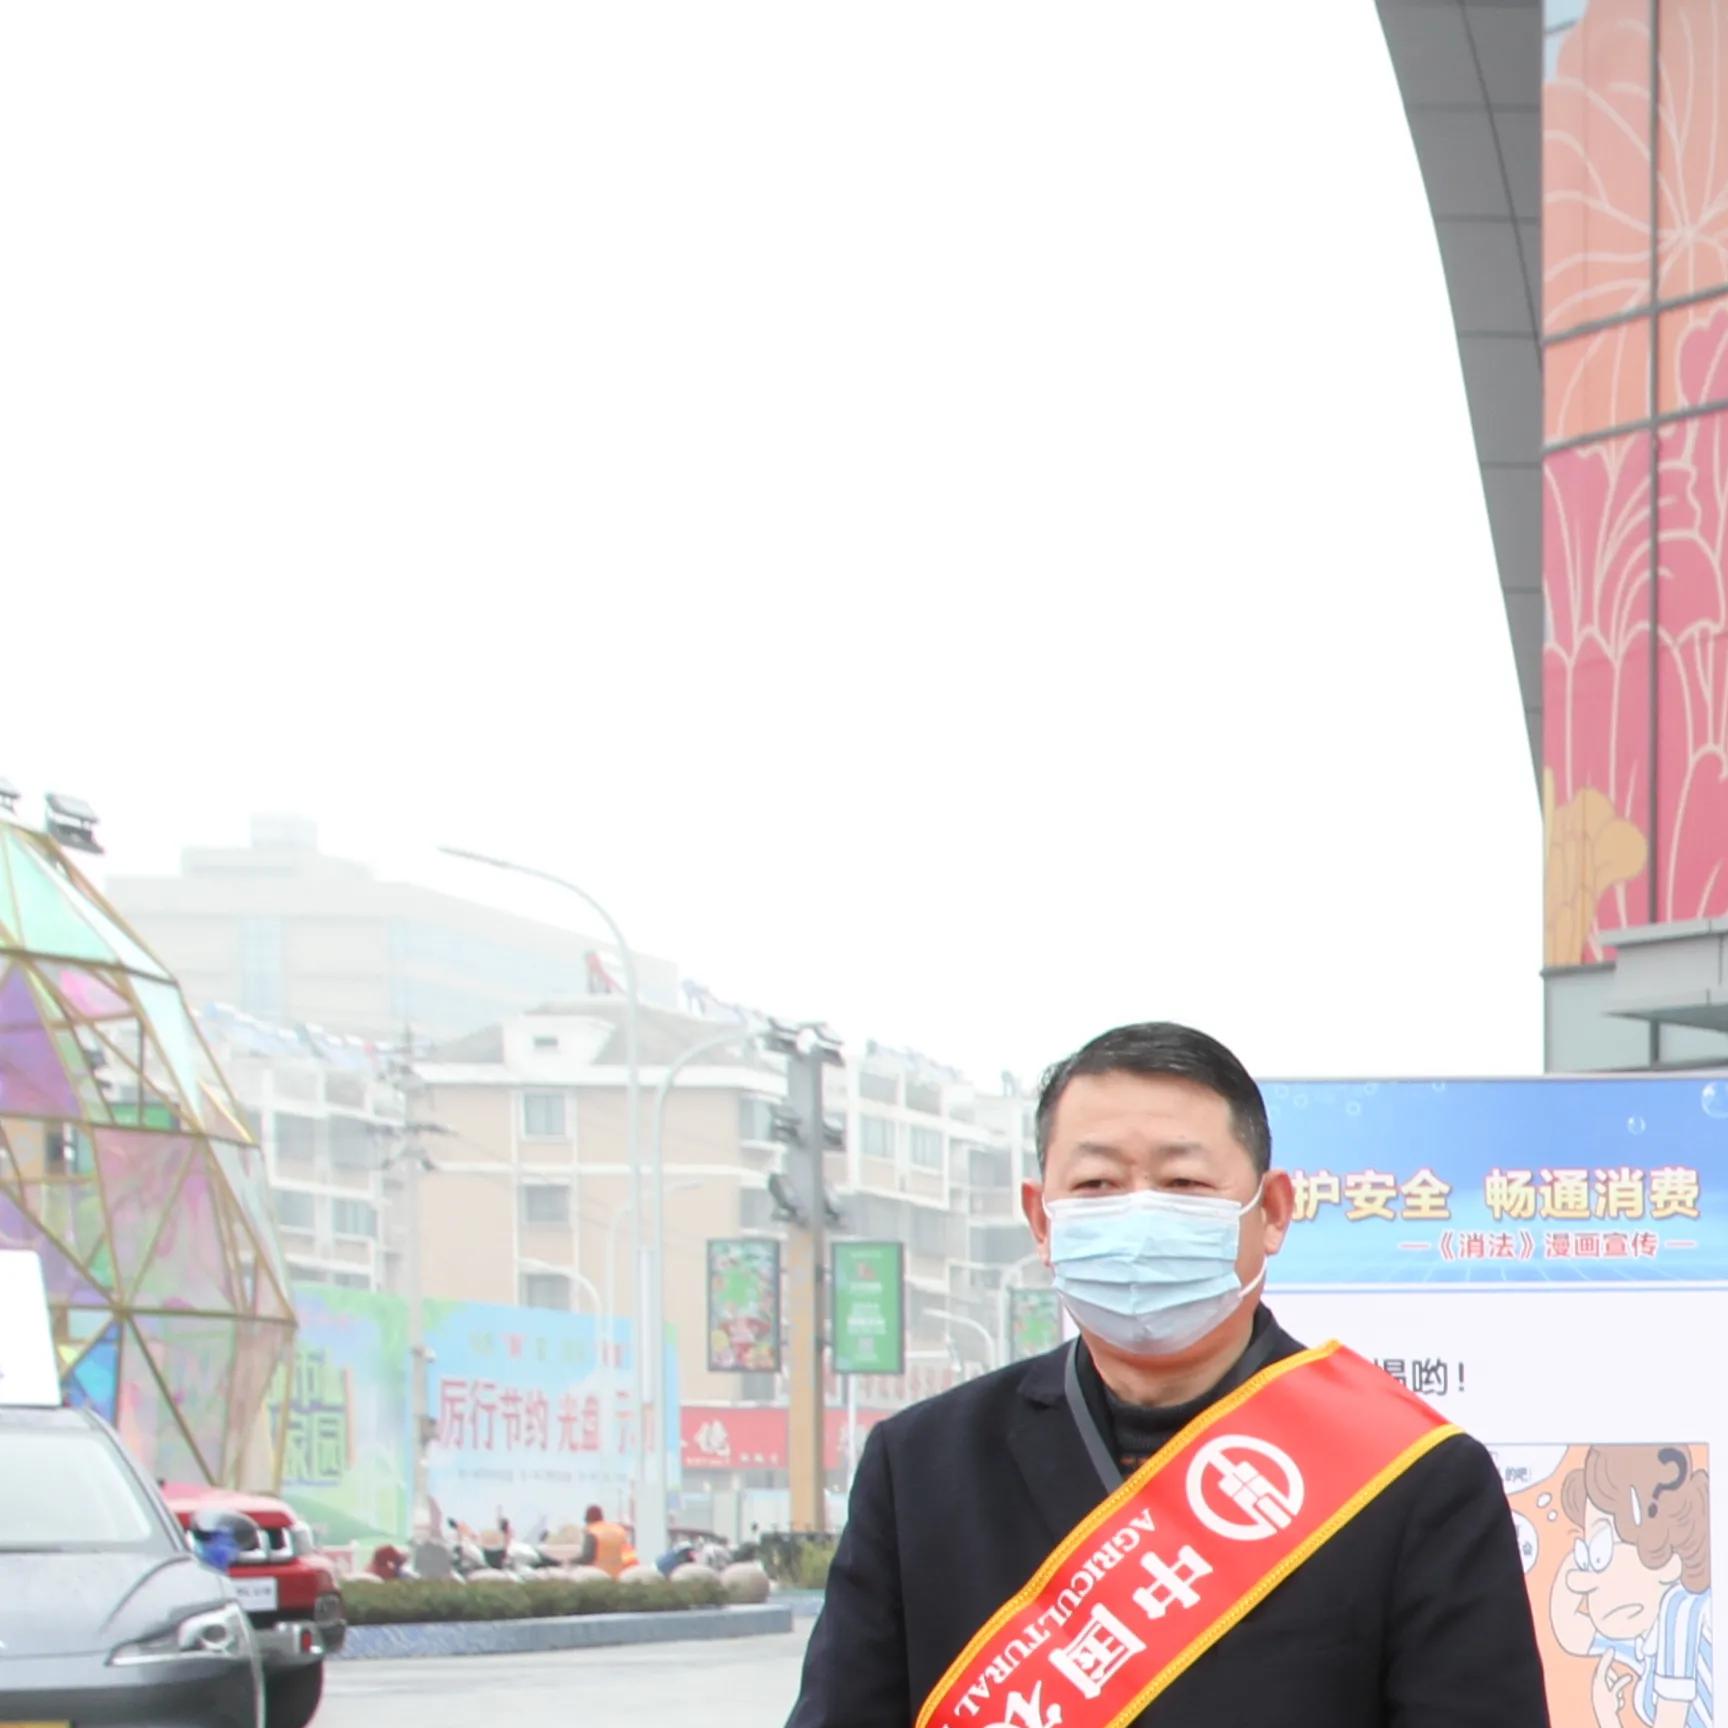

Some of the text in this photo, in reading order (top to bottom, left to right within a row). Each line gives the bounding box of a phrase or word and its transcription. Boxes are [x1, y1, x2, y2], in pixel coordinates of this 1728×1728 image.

[1483, 1165, 1701, 1222] 畅通消费
[954, 1508, 1159, 1719] AGRICULTURAL
